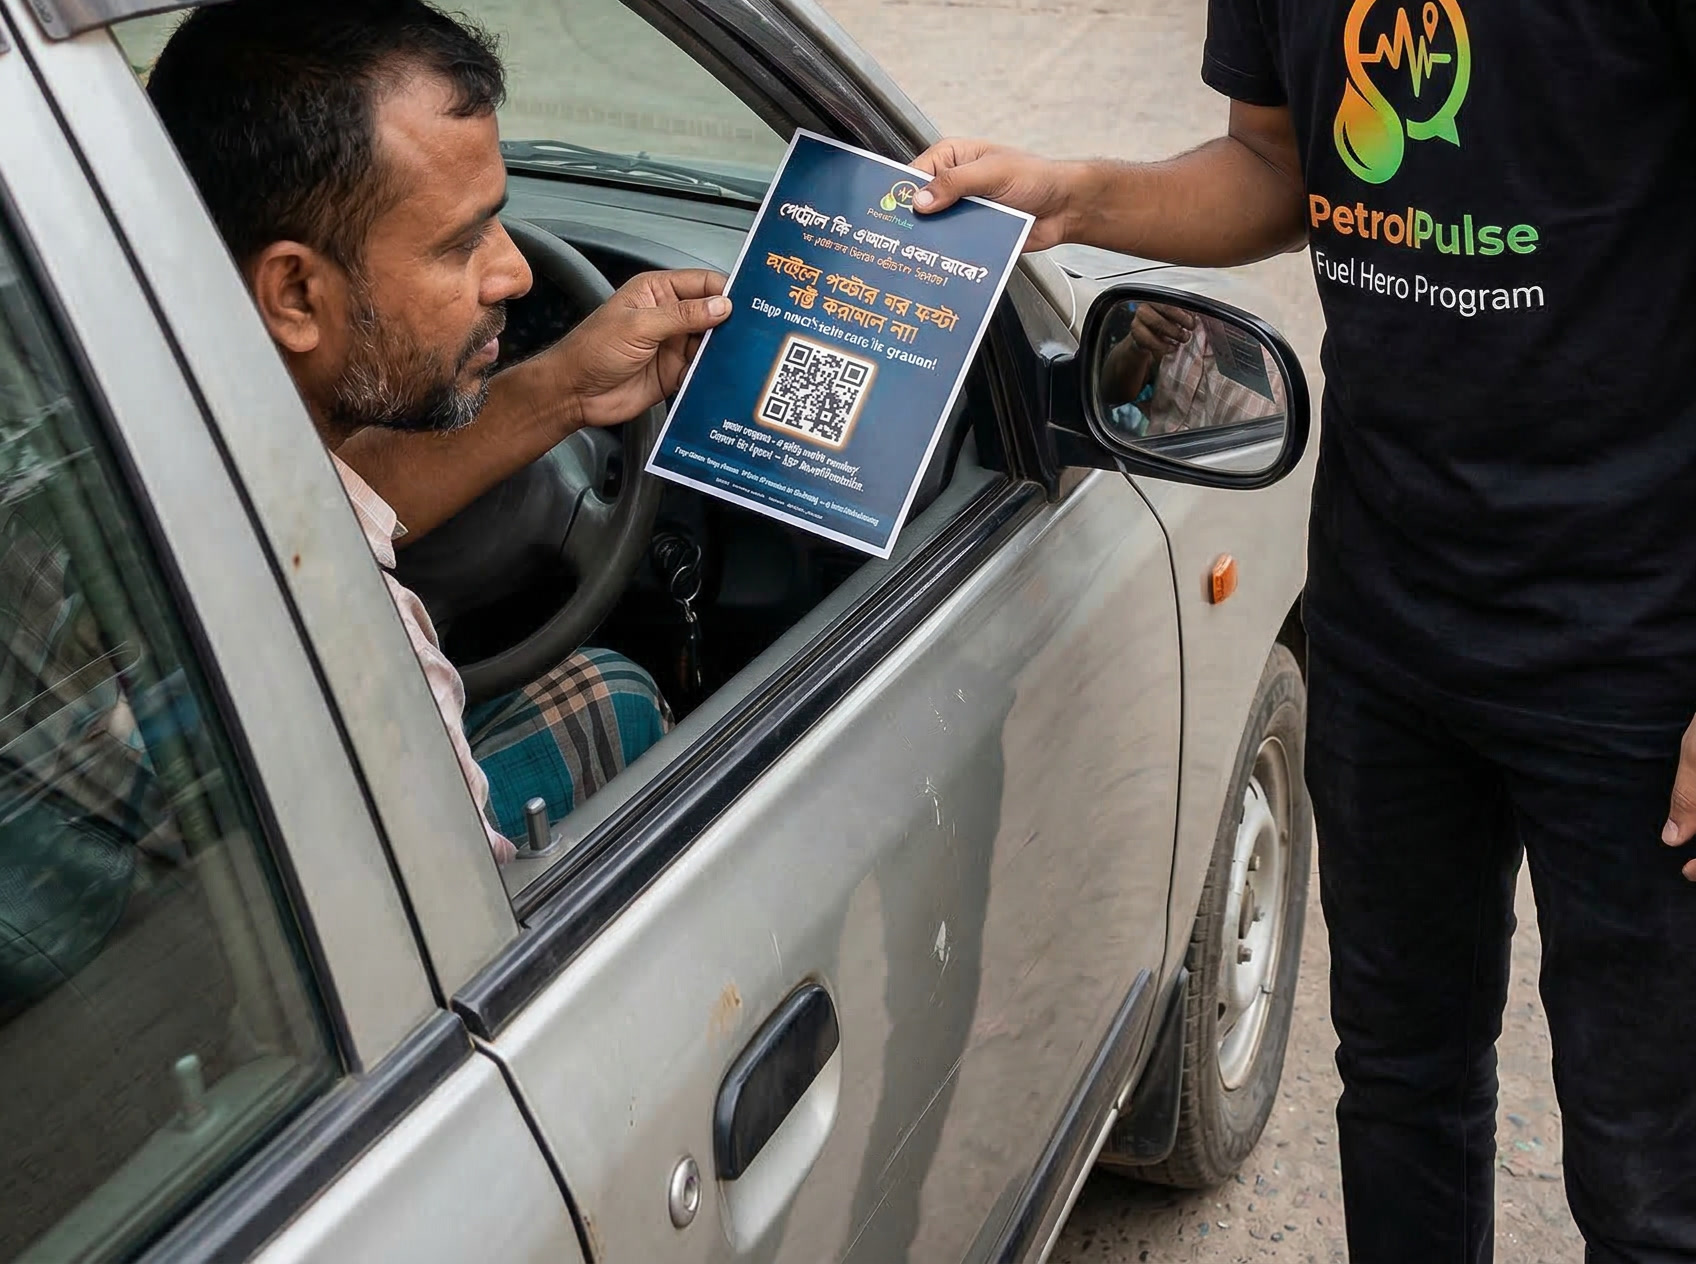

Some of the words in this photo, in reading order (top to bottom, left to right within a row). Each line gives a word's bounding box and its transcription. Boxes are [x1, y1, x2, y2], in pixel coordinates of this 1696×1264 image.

[1309, 193, 1539, 256] PetrolPulse
[1315, 250, 1356, 286] Fuel
[1360, 262, 1409, 299] Hero
[1415, 275, 1545, 317] Program
